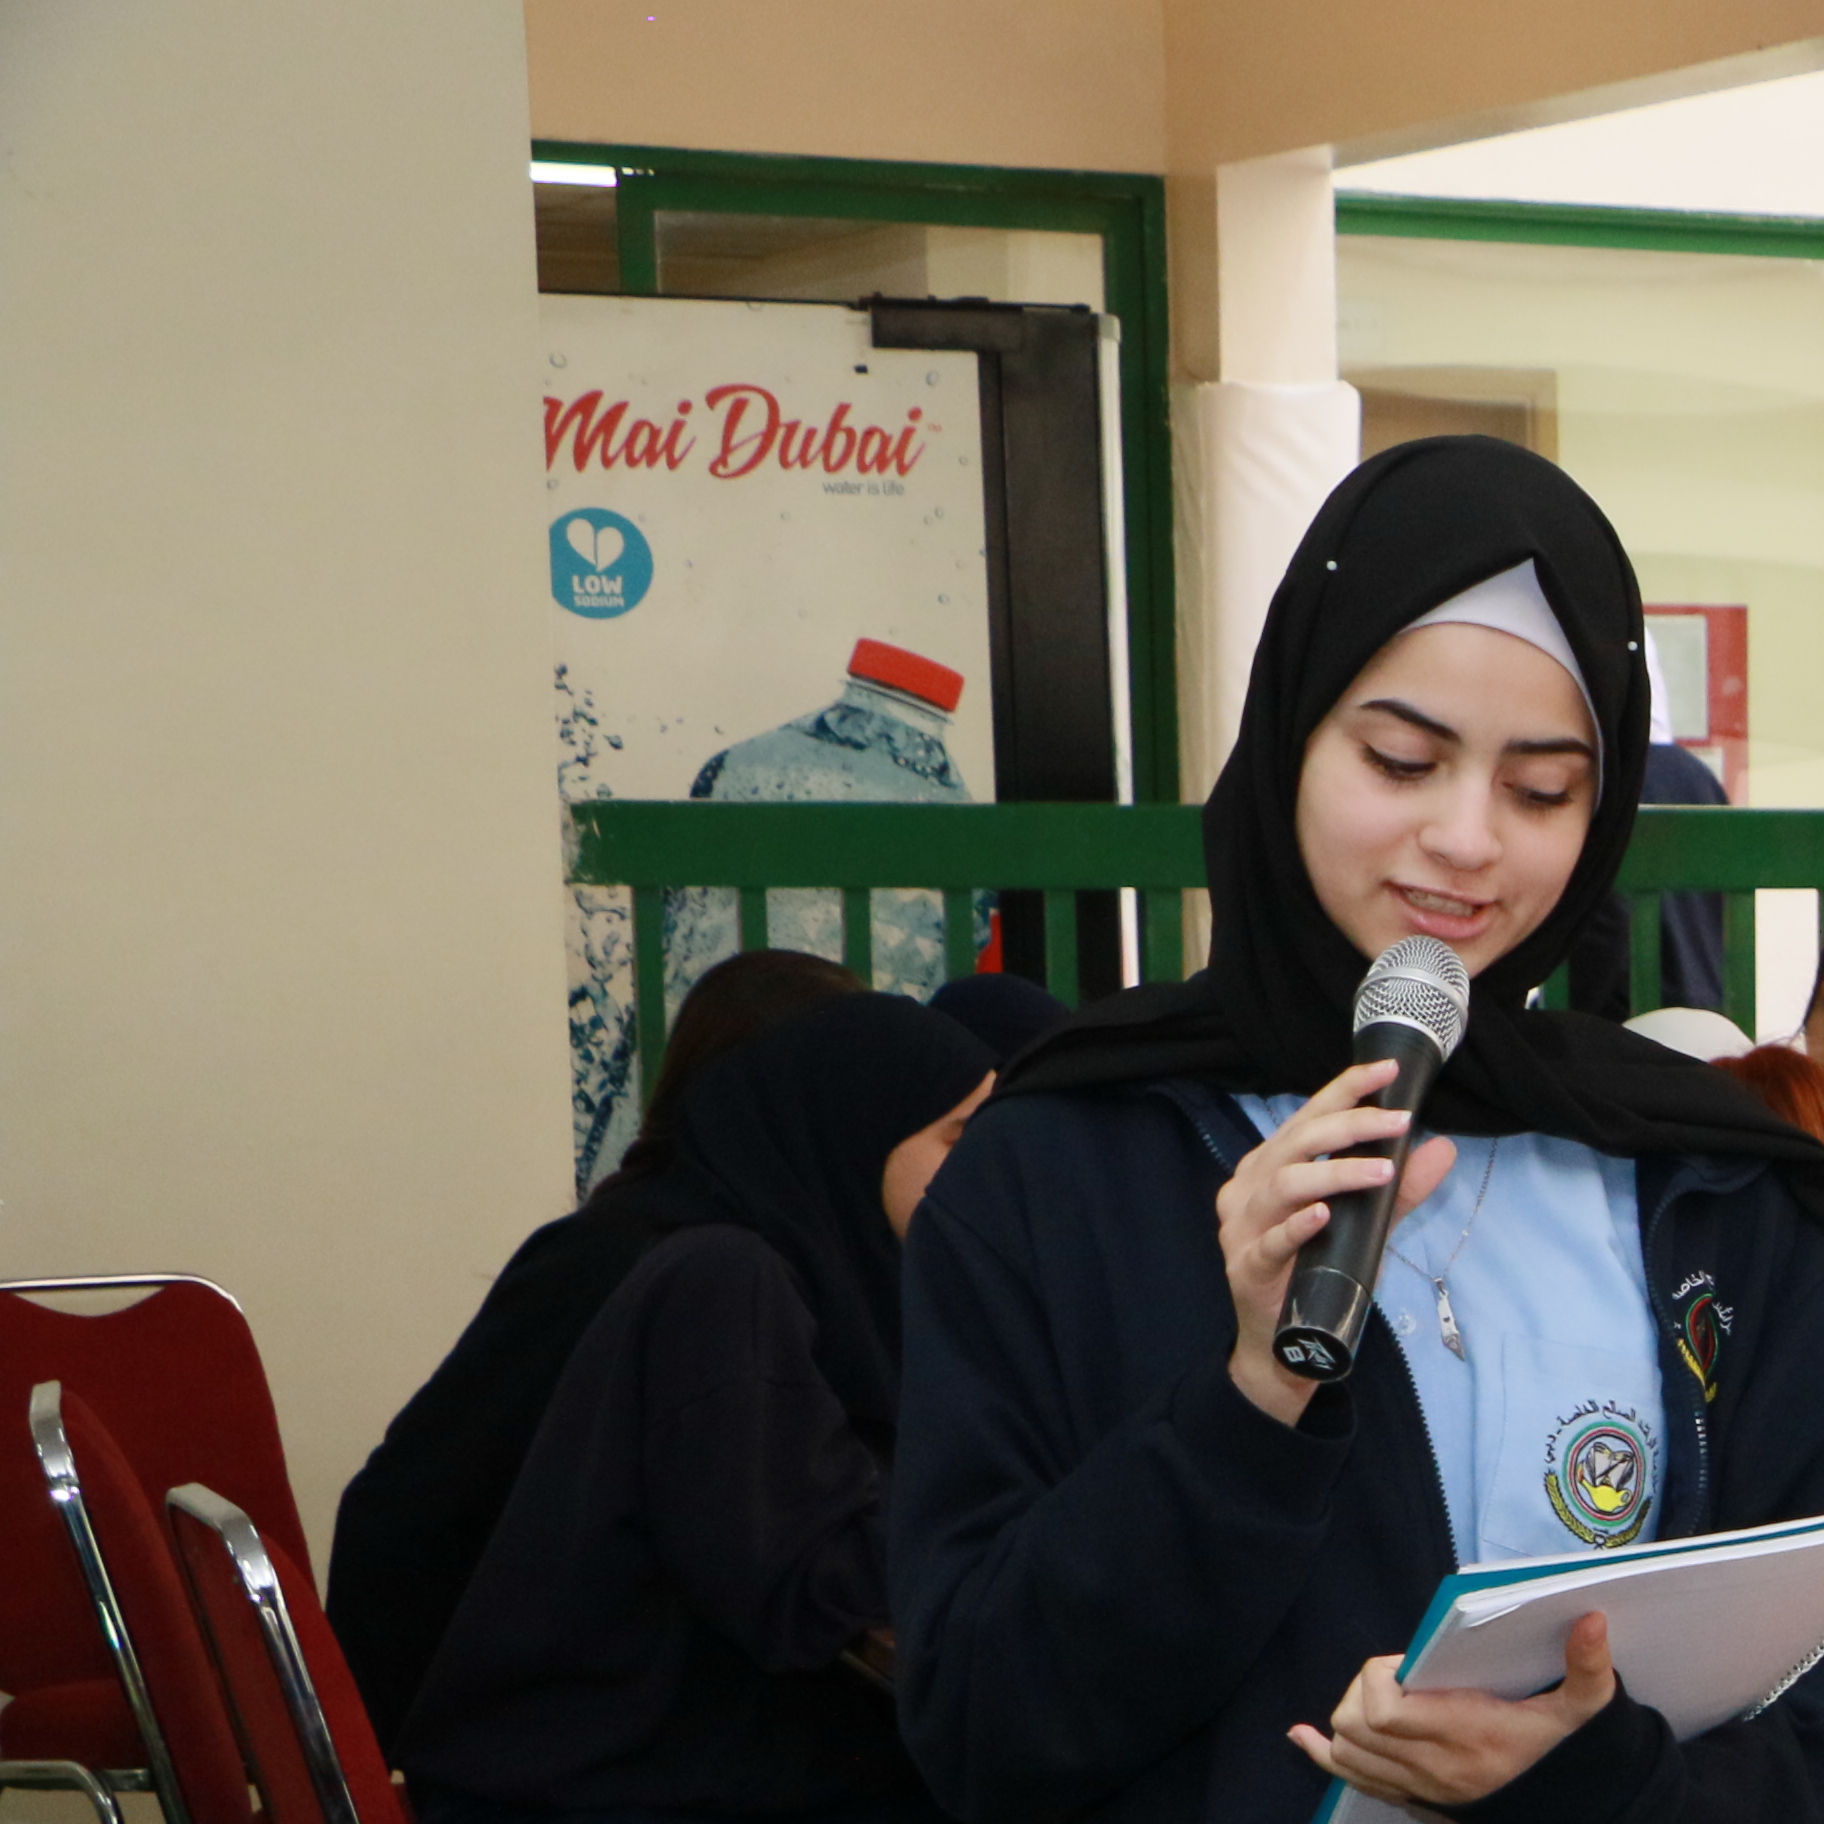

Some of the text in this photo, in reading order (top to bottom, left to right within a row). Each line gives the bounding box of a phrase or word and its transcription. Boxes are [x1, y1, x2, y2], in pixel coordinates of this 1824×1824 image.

[543, 383, 927, 480] Mai Dubai
[822, 480, 905, 496] water is life
[572, 575, 623, 594] LOW
[573, 595, 624, 607] SODIUM
